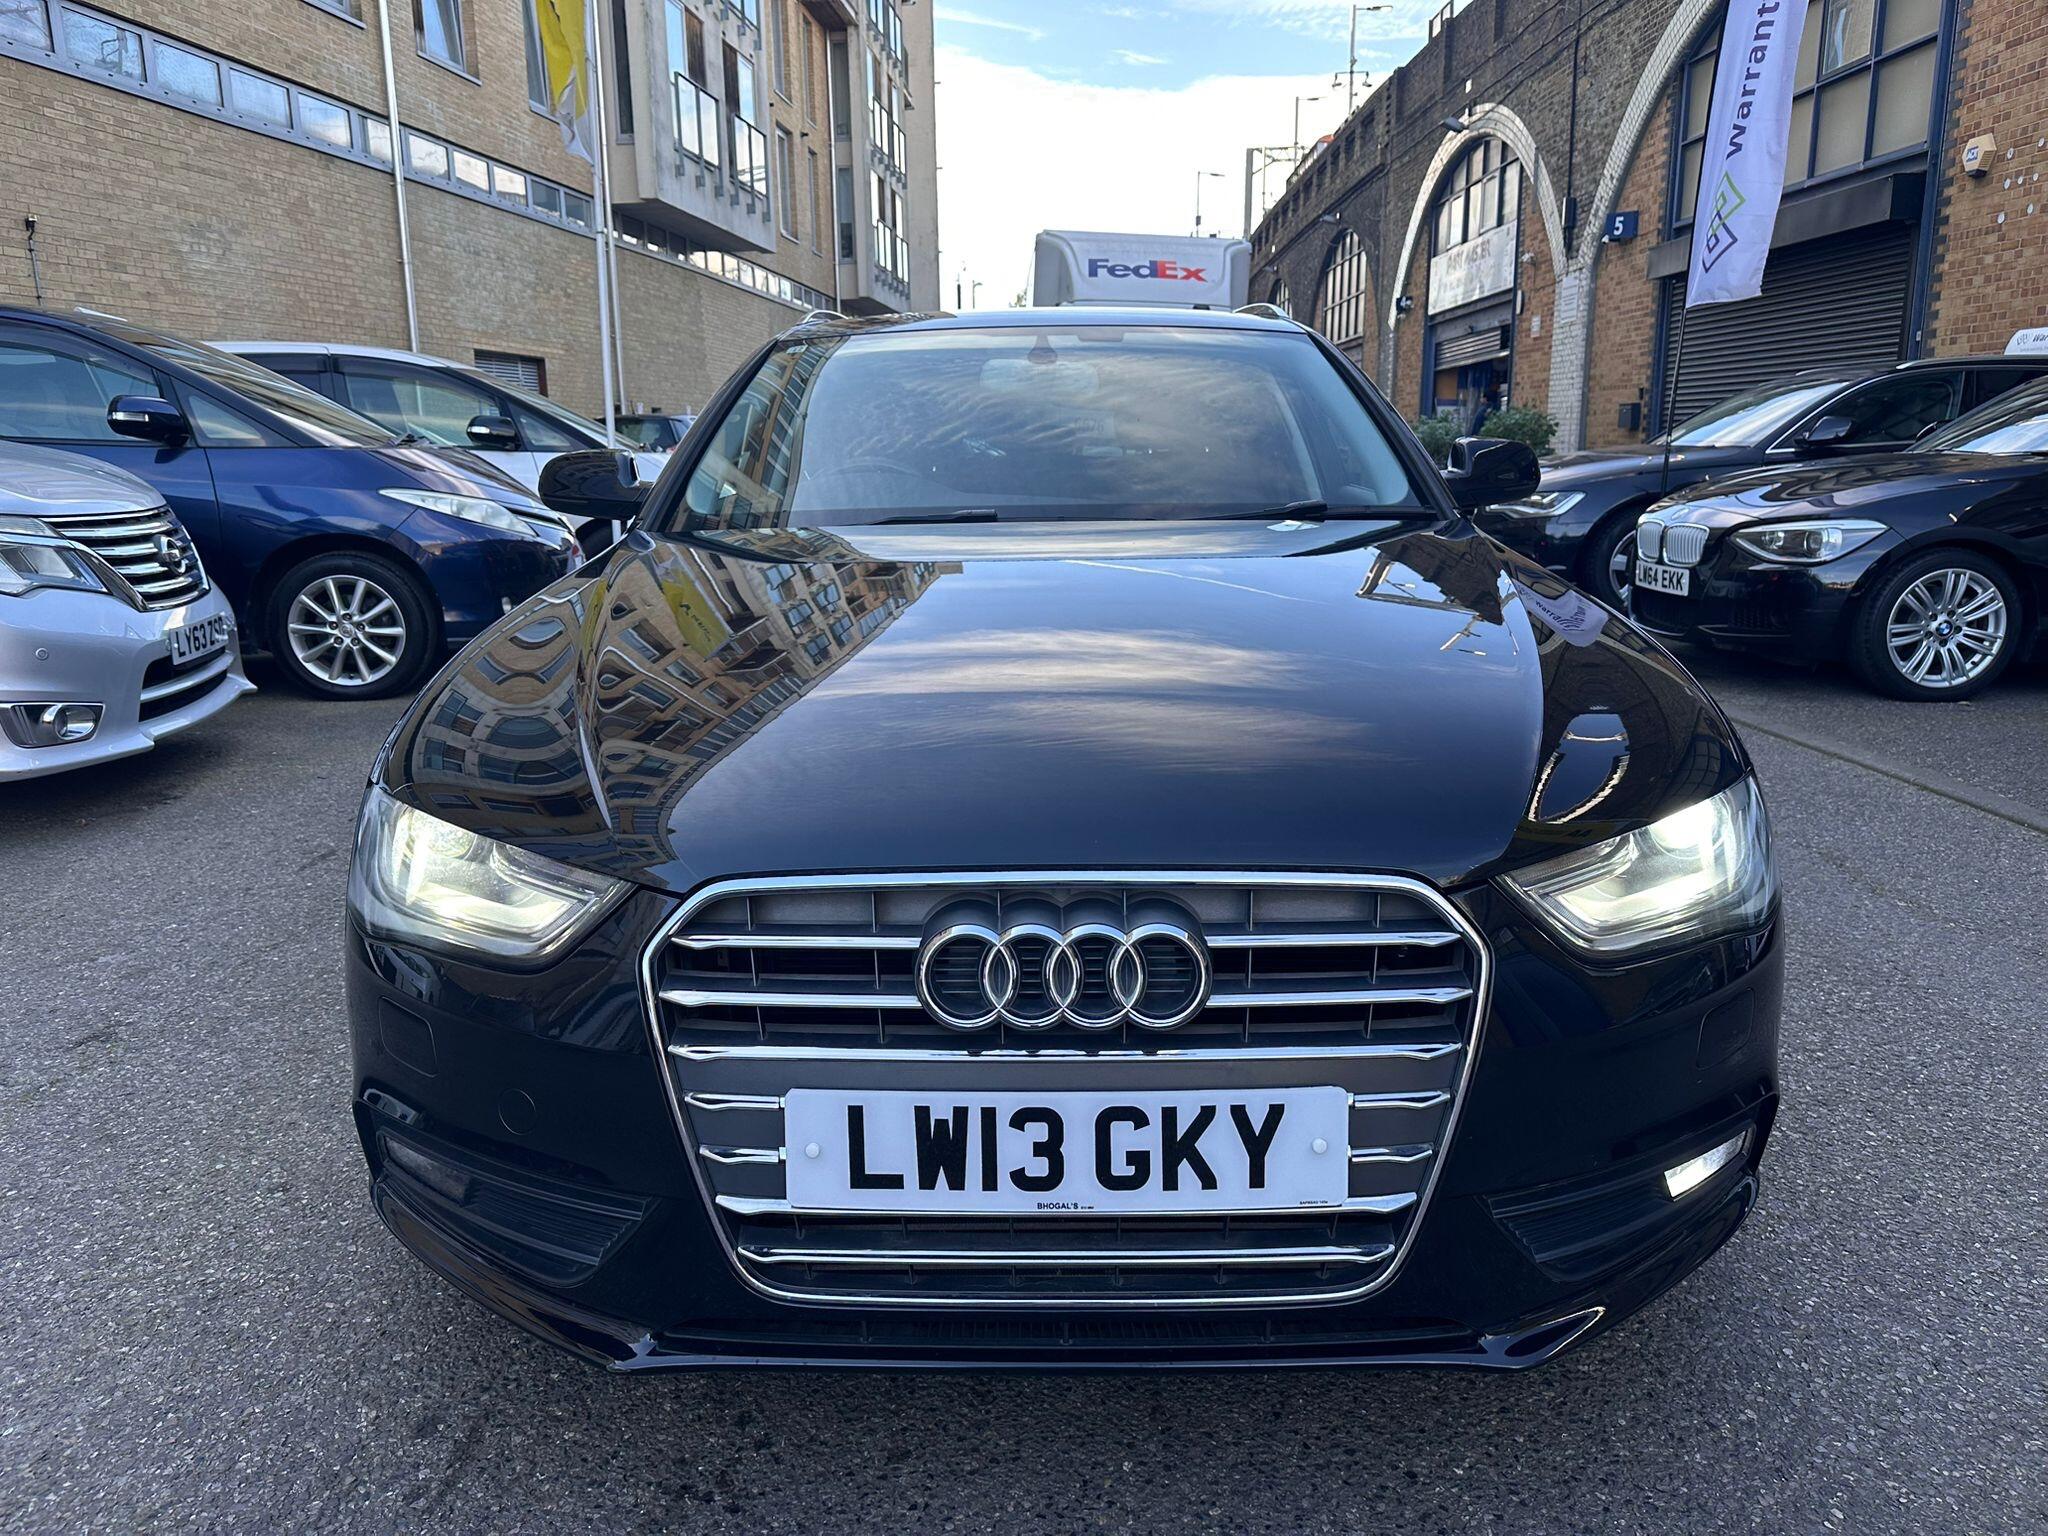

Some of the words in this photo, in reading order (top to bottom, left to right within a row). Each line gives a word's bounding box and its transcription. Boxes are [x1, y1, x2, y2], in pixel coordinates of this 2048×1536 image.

[1726, 1, 1780, 160] warrant
[1613, 216, 1624, 236] 5
[1088, 259, 1208, 282] FedEx
[1638, 564, 1659, 587] LW64
[1661, 569, 1684, 592] EKK
[175, 624, 207, 658] LY63
[847, 1104, 1065, 1192] LW13
[1094, 1103, 1286, 1192] GKY
[1037, 1202, 1079, 1210] BHOGAL'S
